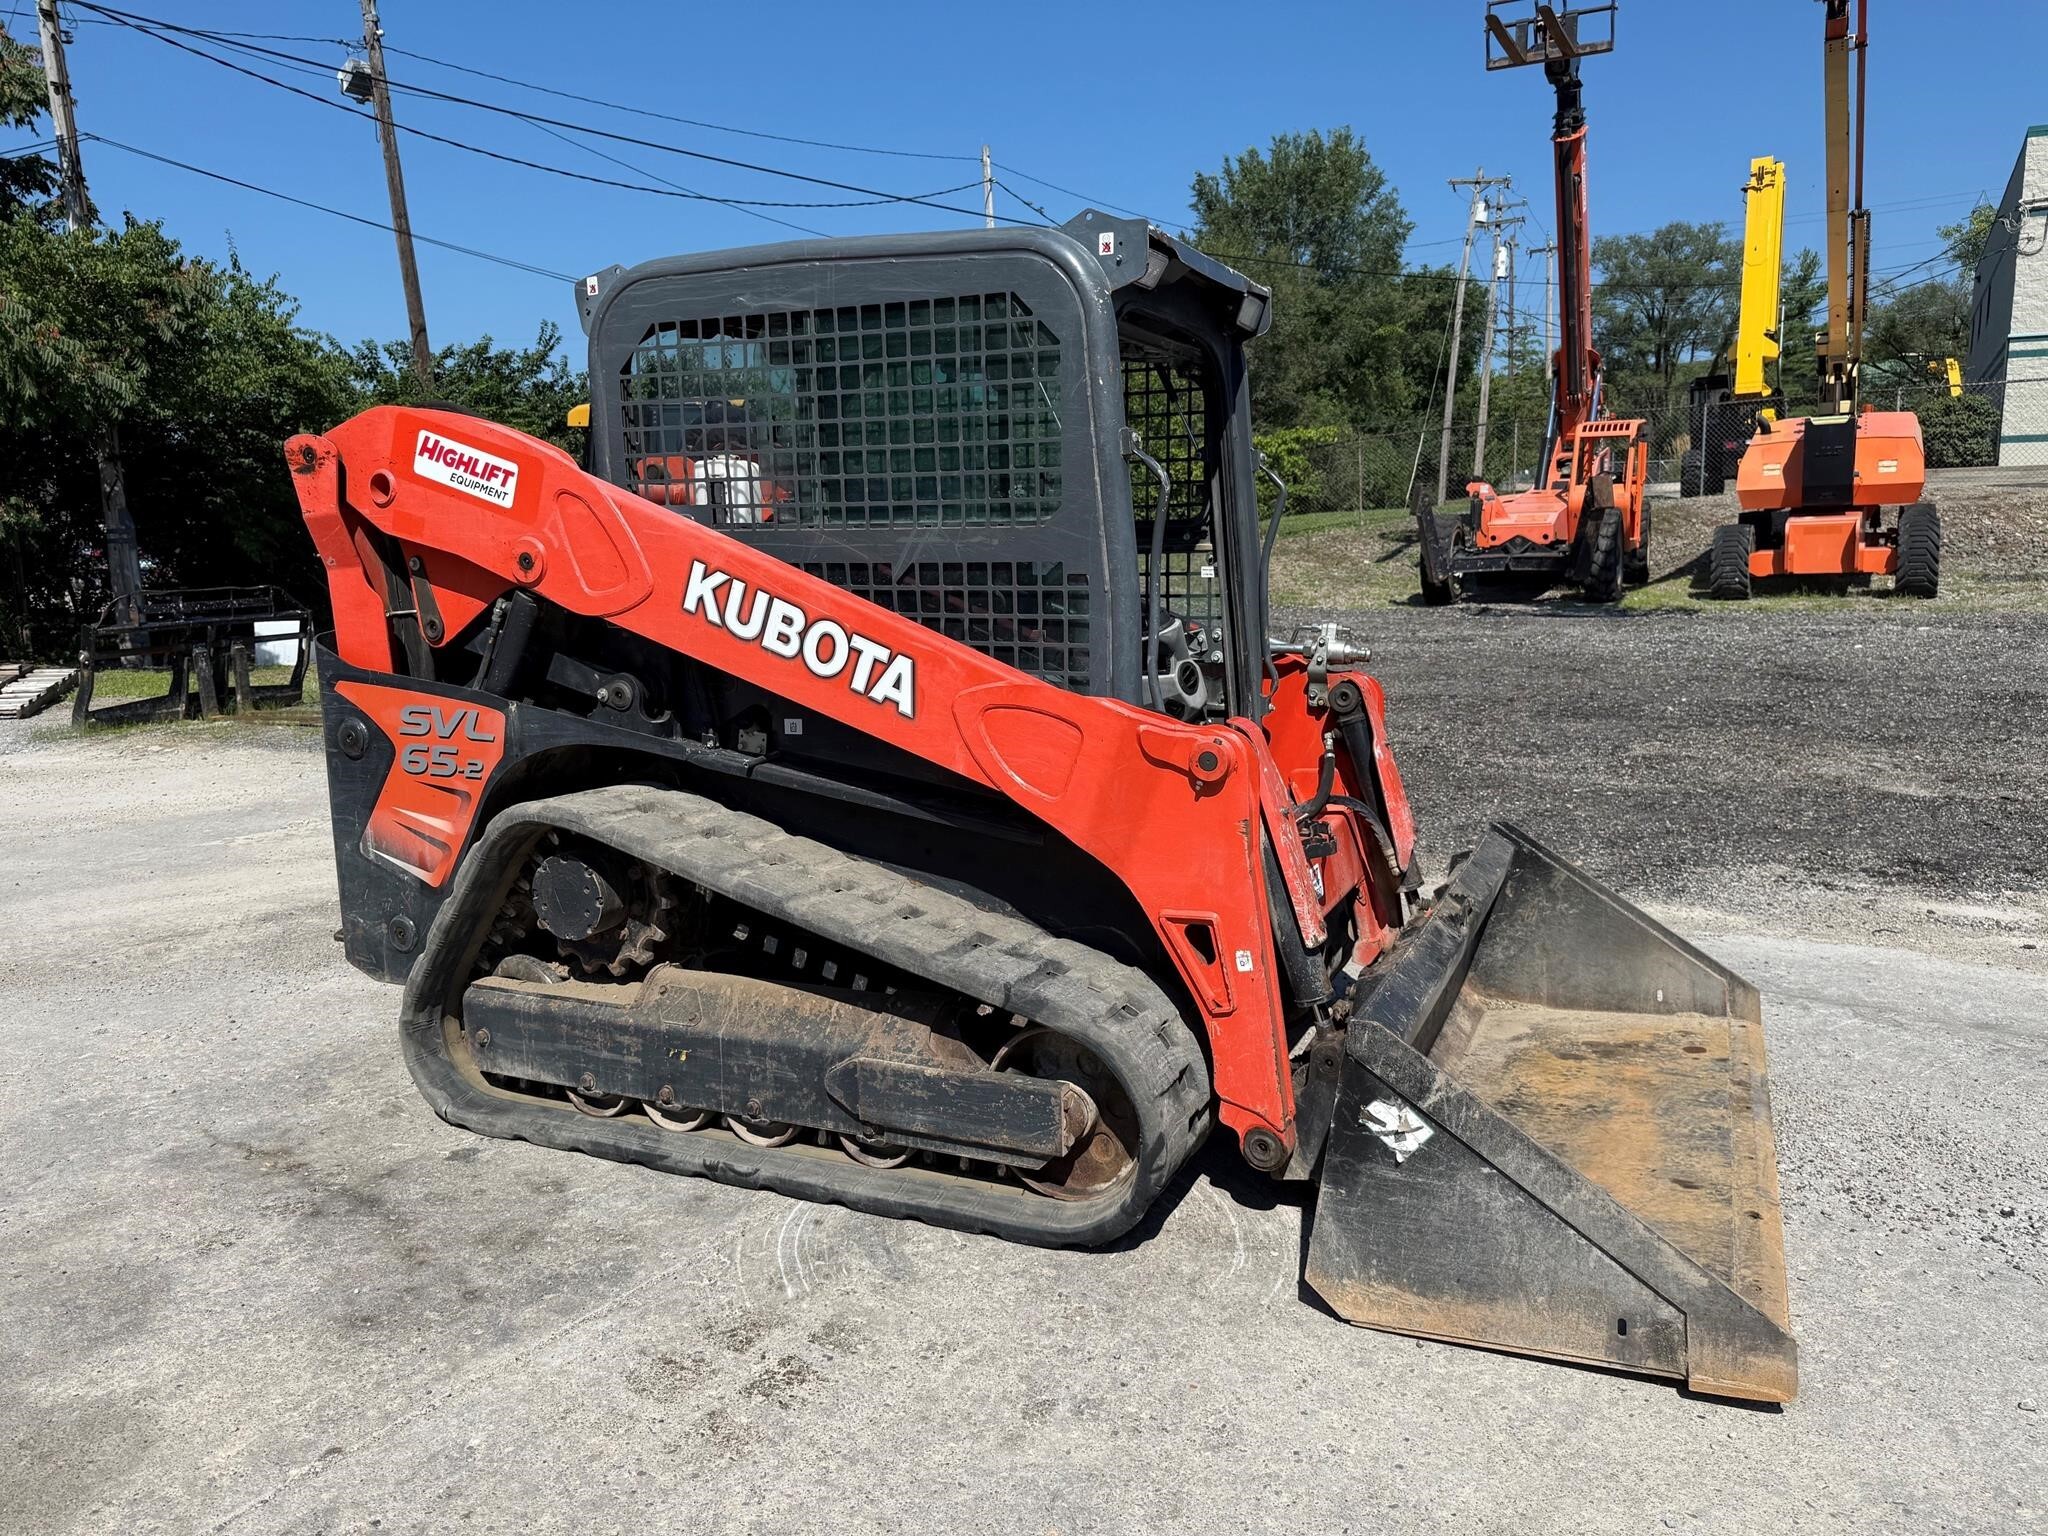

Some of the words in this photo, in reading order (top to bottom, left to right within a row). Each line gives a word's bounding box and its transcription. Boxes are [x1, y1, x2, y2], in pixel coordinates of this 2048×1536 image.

[418, 435, 515, 488] HIGHLIFT
[449, 472, 509, 501] EQUIPMENT
[682, 559, 914, 719] KUBOTA
[399, 705, 496, 743] SVL
[401, 743, 484, 780] 65-2
